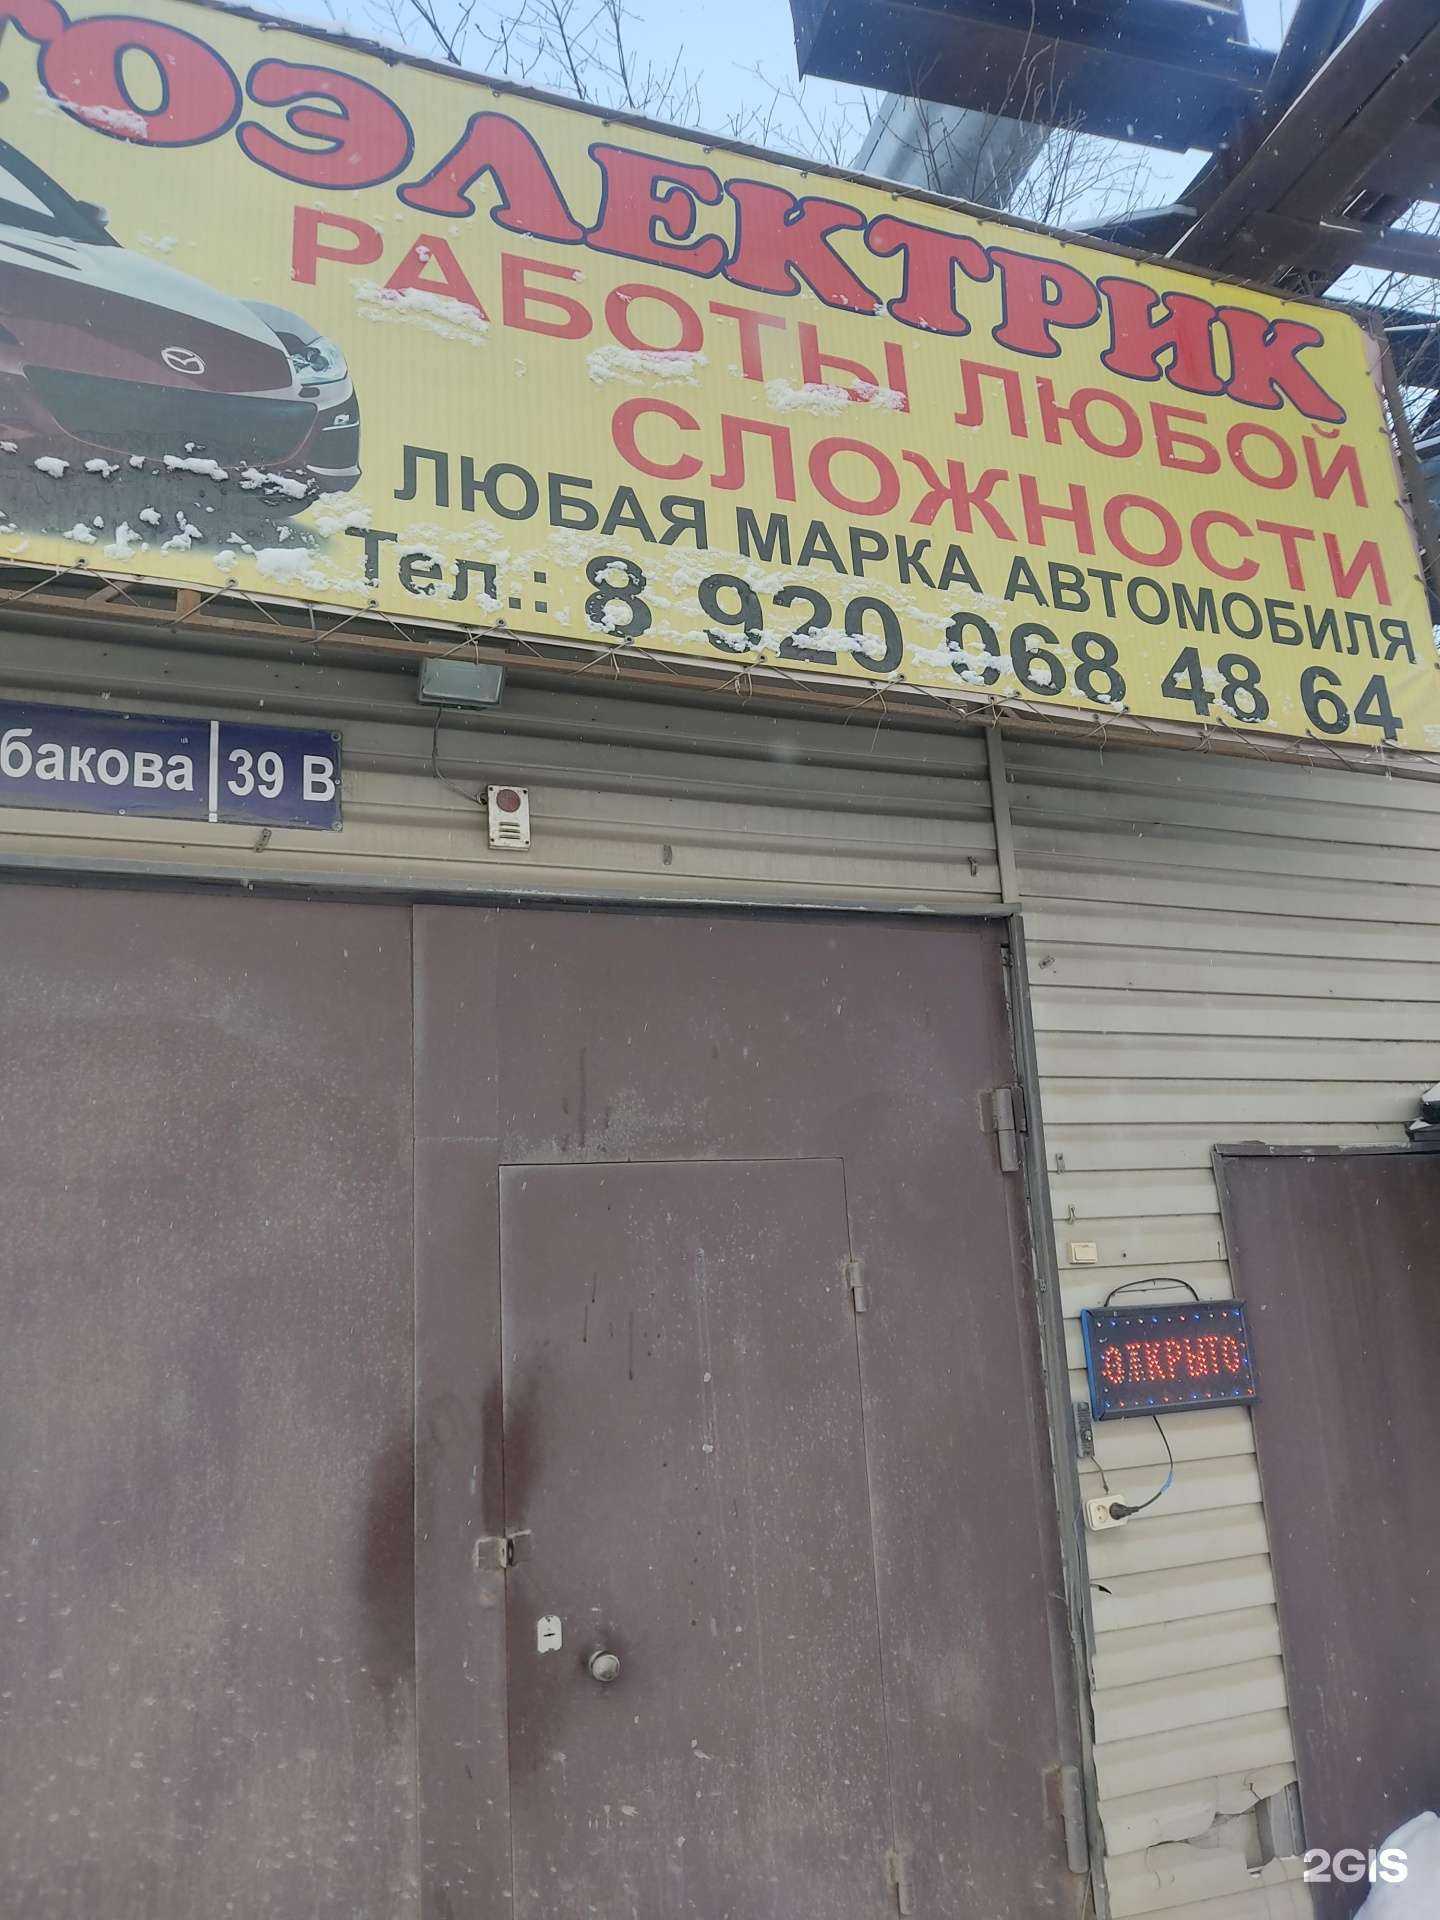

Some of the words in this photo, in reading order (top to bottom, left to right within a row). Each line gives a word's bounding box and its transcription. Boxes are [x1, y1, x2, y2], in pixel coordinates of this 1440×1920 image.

[290, 205, 911, 413] РАБОТЫ
[954, 359, 1369, 508] ЛЮБОЙ
[394, 444, 709, 550] ЛЮБАЯ
[736, 506, 983, 594] МАРКА
[1004, 555, 1418, 664] АВТОМОБИЛЯ
[612, 397, 1392, 606] СЛОЖНОСТИ
[344, 526, 548, 613] Тел.:
[584, 555, 652, 638] 8
[698, 573, 903, 674] 920
[945, 611, 1127, 704] 068
[1162, 646, 1271, 723] 48
[1300, 665, 1404, 741] 64
[0, 727, 194, 792] бакова
[227, 748, 285, 799] 39
[303, 755, 336, 802] В
[1102, 1336, 1240, 1384] ОТКРЫТО
